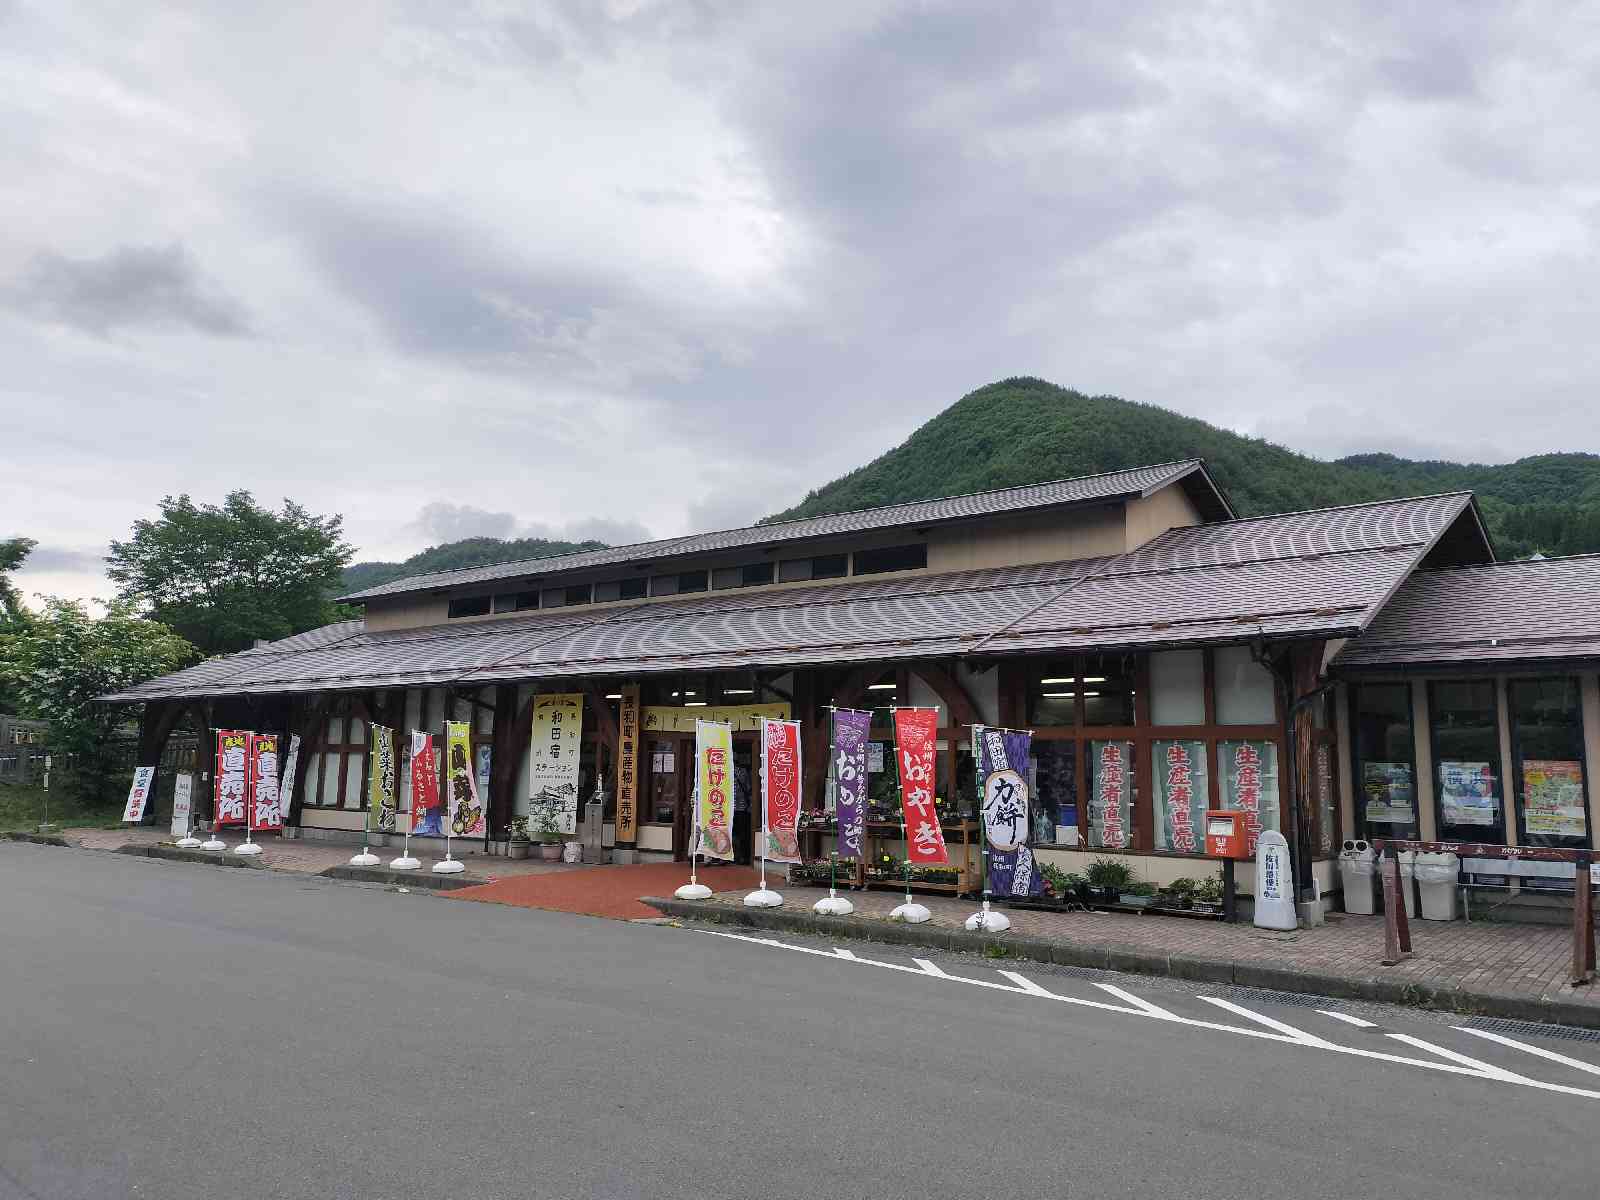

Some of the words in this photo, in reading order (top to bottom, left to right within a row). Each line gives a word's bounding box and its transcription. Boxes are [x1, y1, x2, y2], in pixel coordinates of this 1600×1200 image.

[535, 763, 573, 772] ステーション
[550, 711, 563, 759] 和田宿
[904, 751, 938, 855] おやき
[984, 778, 1024, 845] 力餅
[1101, 745, 1125, 849] 生産者直売
[1167, 744, 1196, 850] 生産者直売
